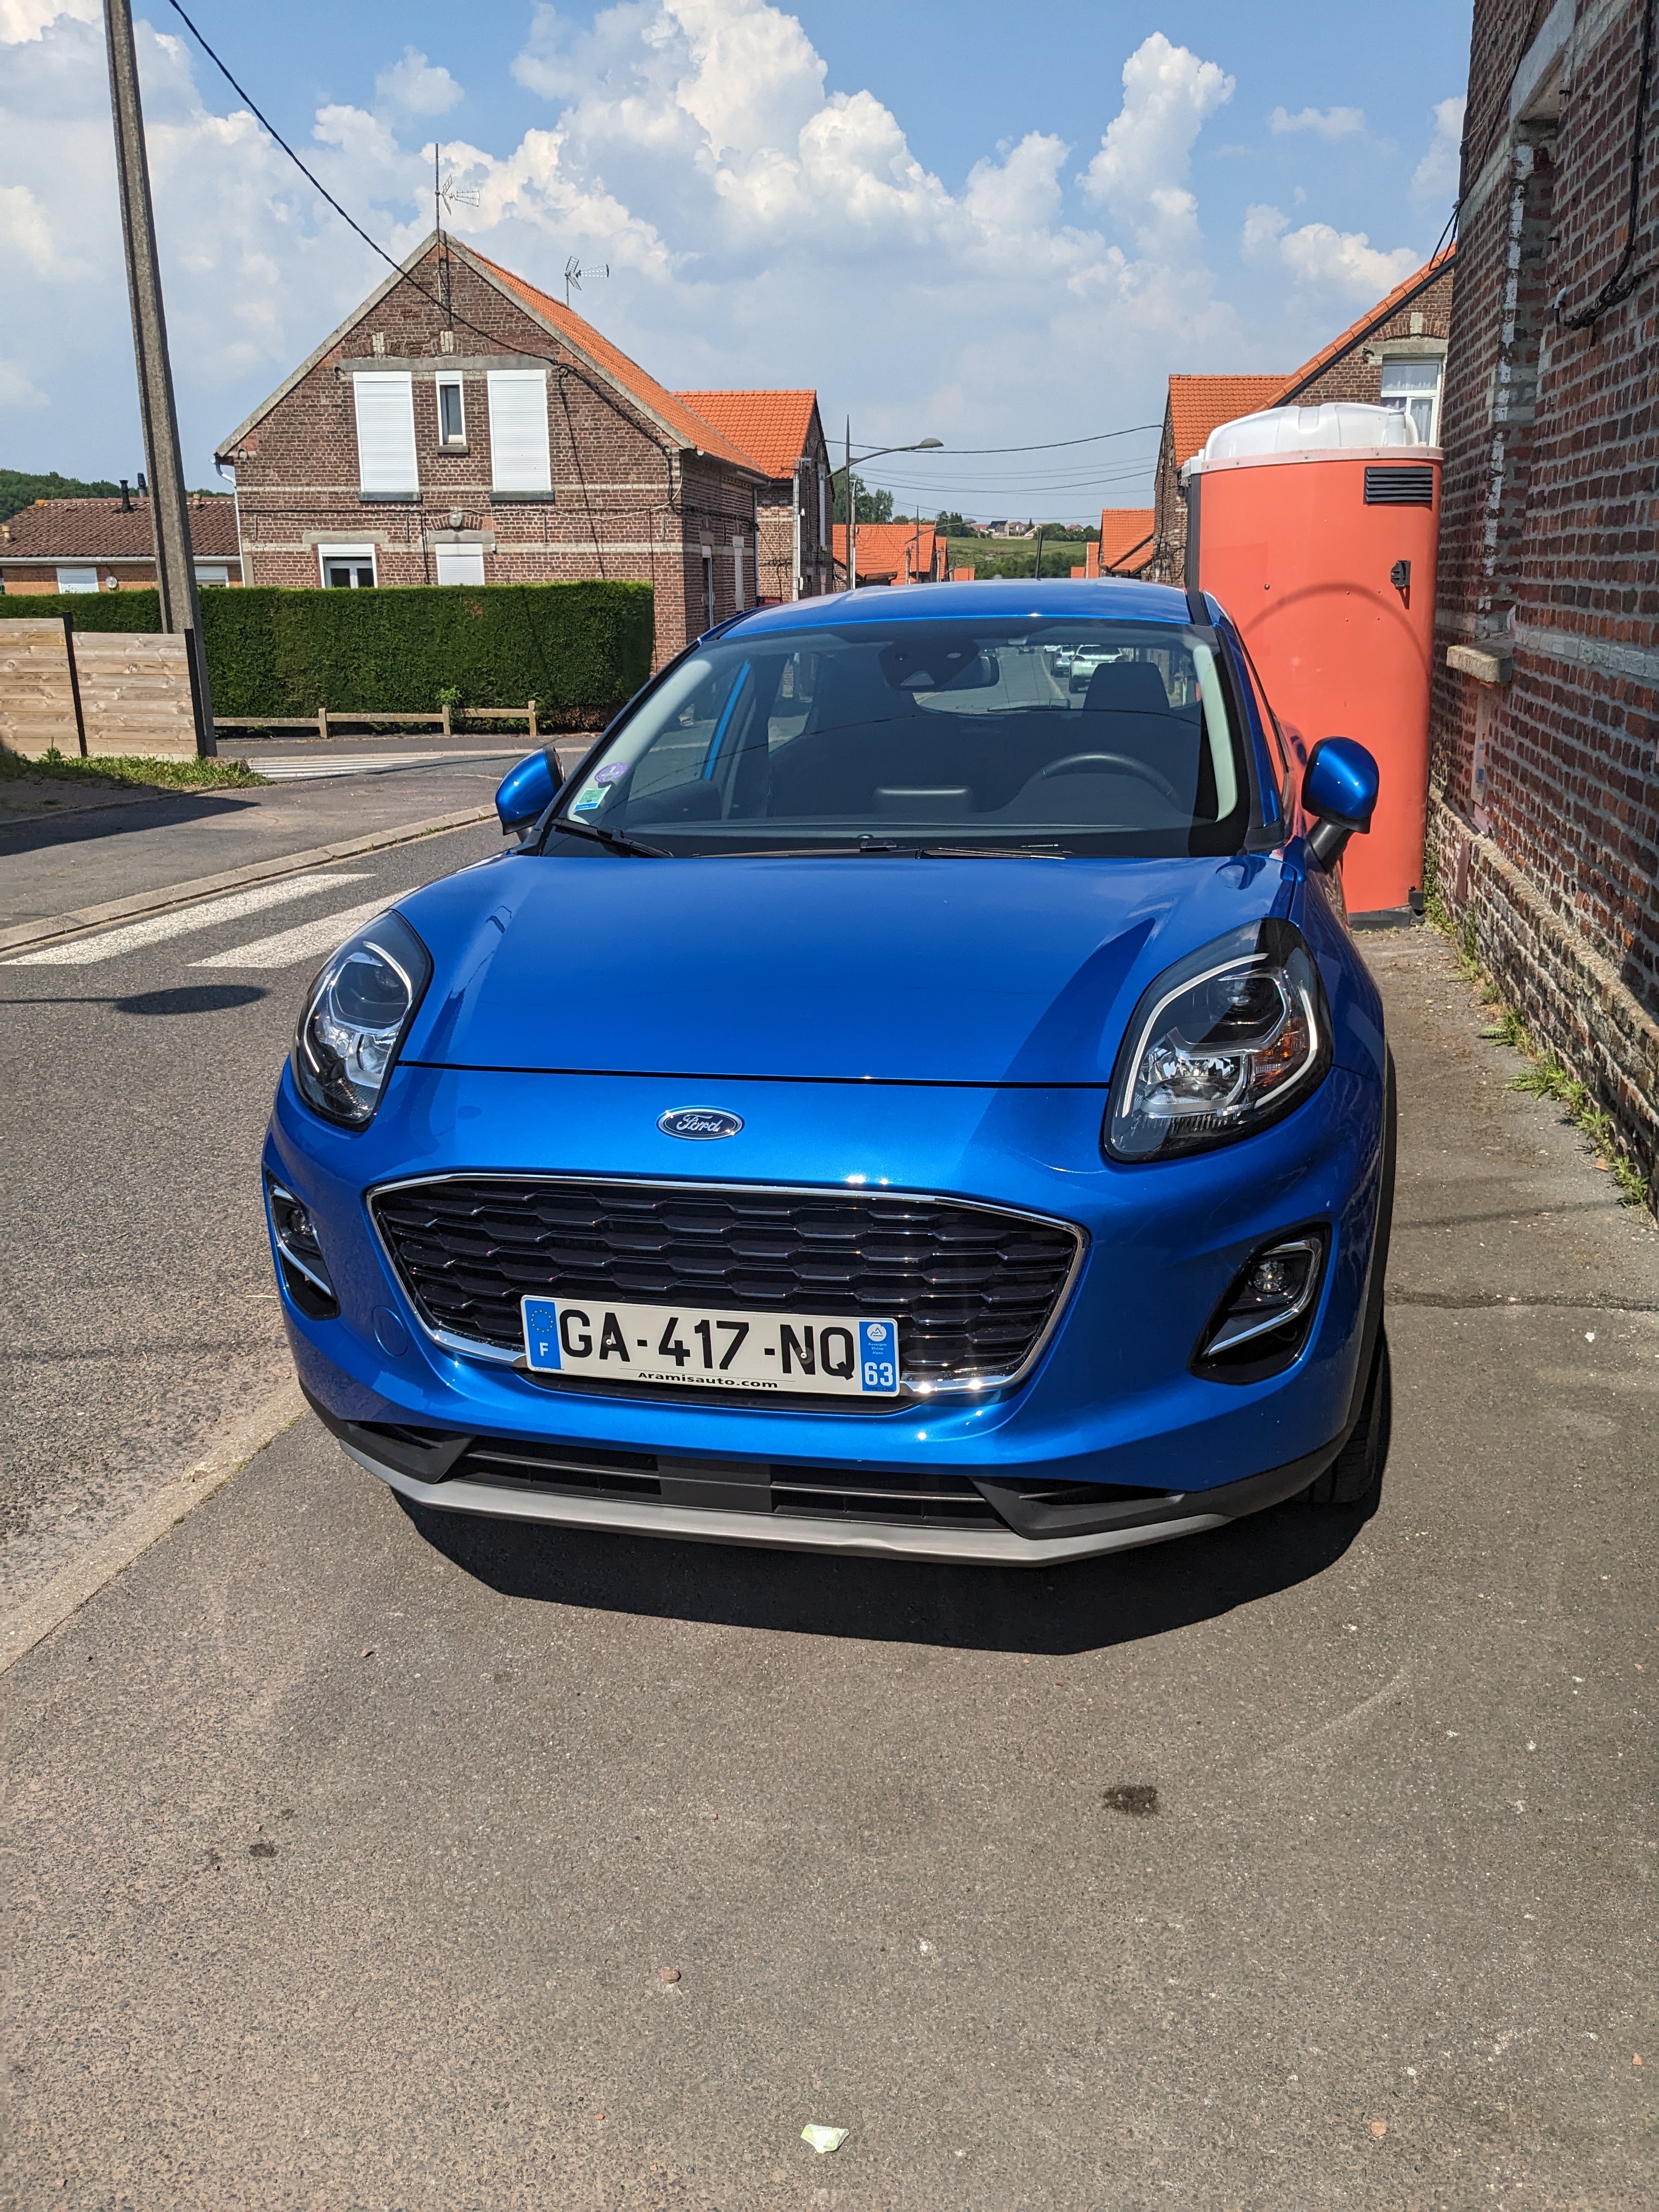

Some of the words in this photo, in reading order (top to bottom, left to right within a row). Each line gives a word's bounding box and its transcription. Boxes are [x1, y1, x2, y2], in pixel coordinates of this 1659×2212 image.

[676, 1114, 723, 1132] Ford
[539, 1342, 549, 1356] F
[638, 1372, 778, 1389] Aramisauto.com
[864, 1362, 893, 1386] 63
